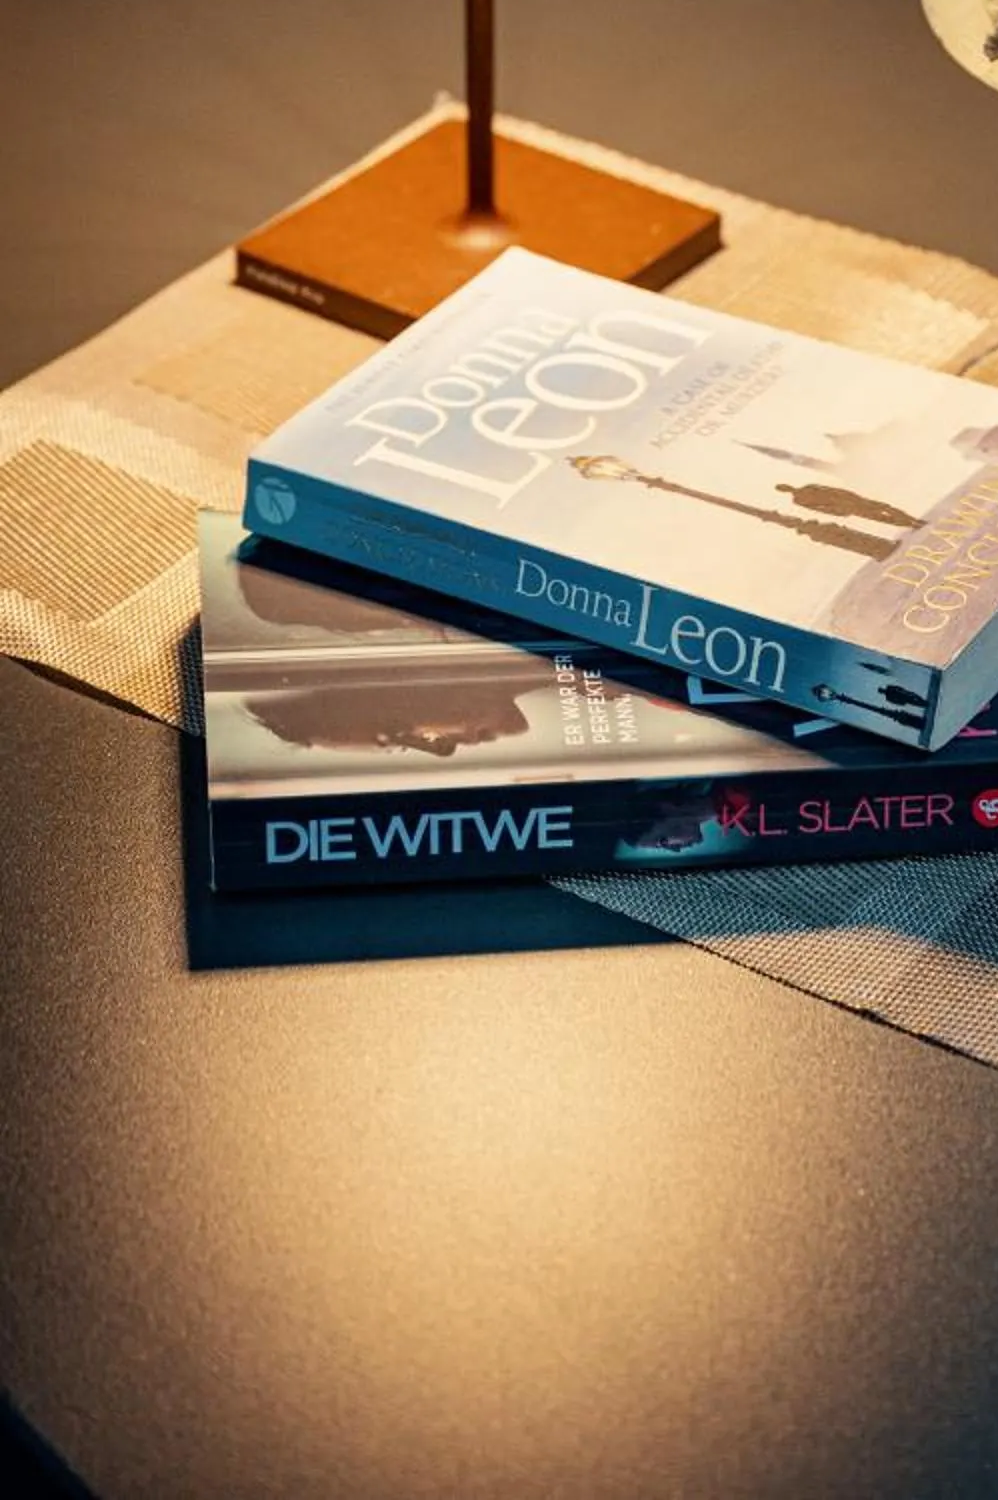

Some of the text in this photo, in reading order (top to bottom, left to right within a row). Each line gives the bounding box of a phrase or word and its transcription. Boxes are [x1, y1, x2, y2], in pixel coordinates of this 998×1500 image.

[346, 307, 579, 447] Donna
[354, 309, 713, 510] Leon
[515, 557, 787, 694] Donna Leon
[553, 653, 585, 746] ER WAR DER
[583, 667, 612, 745] PERFEKTE
[265, 805, 574, 865] DIE WITWE
[718, 793, 956, 838] K.L. SLATER
